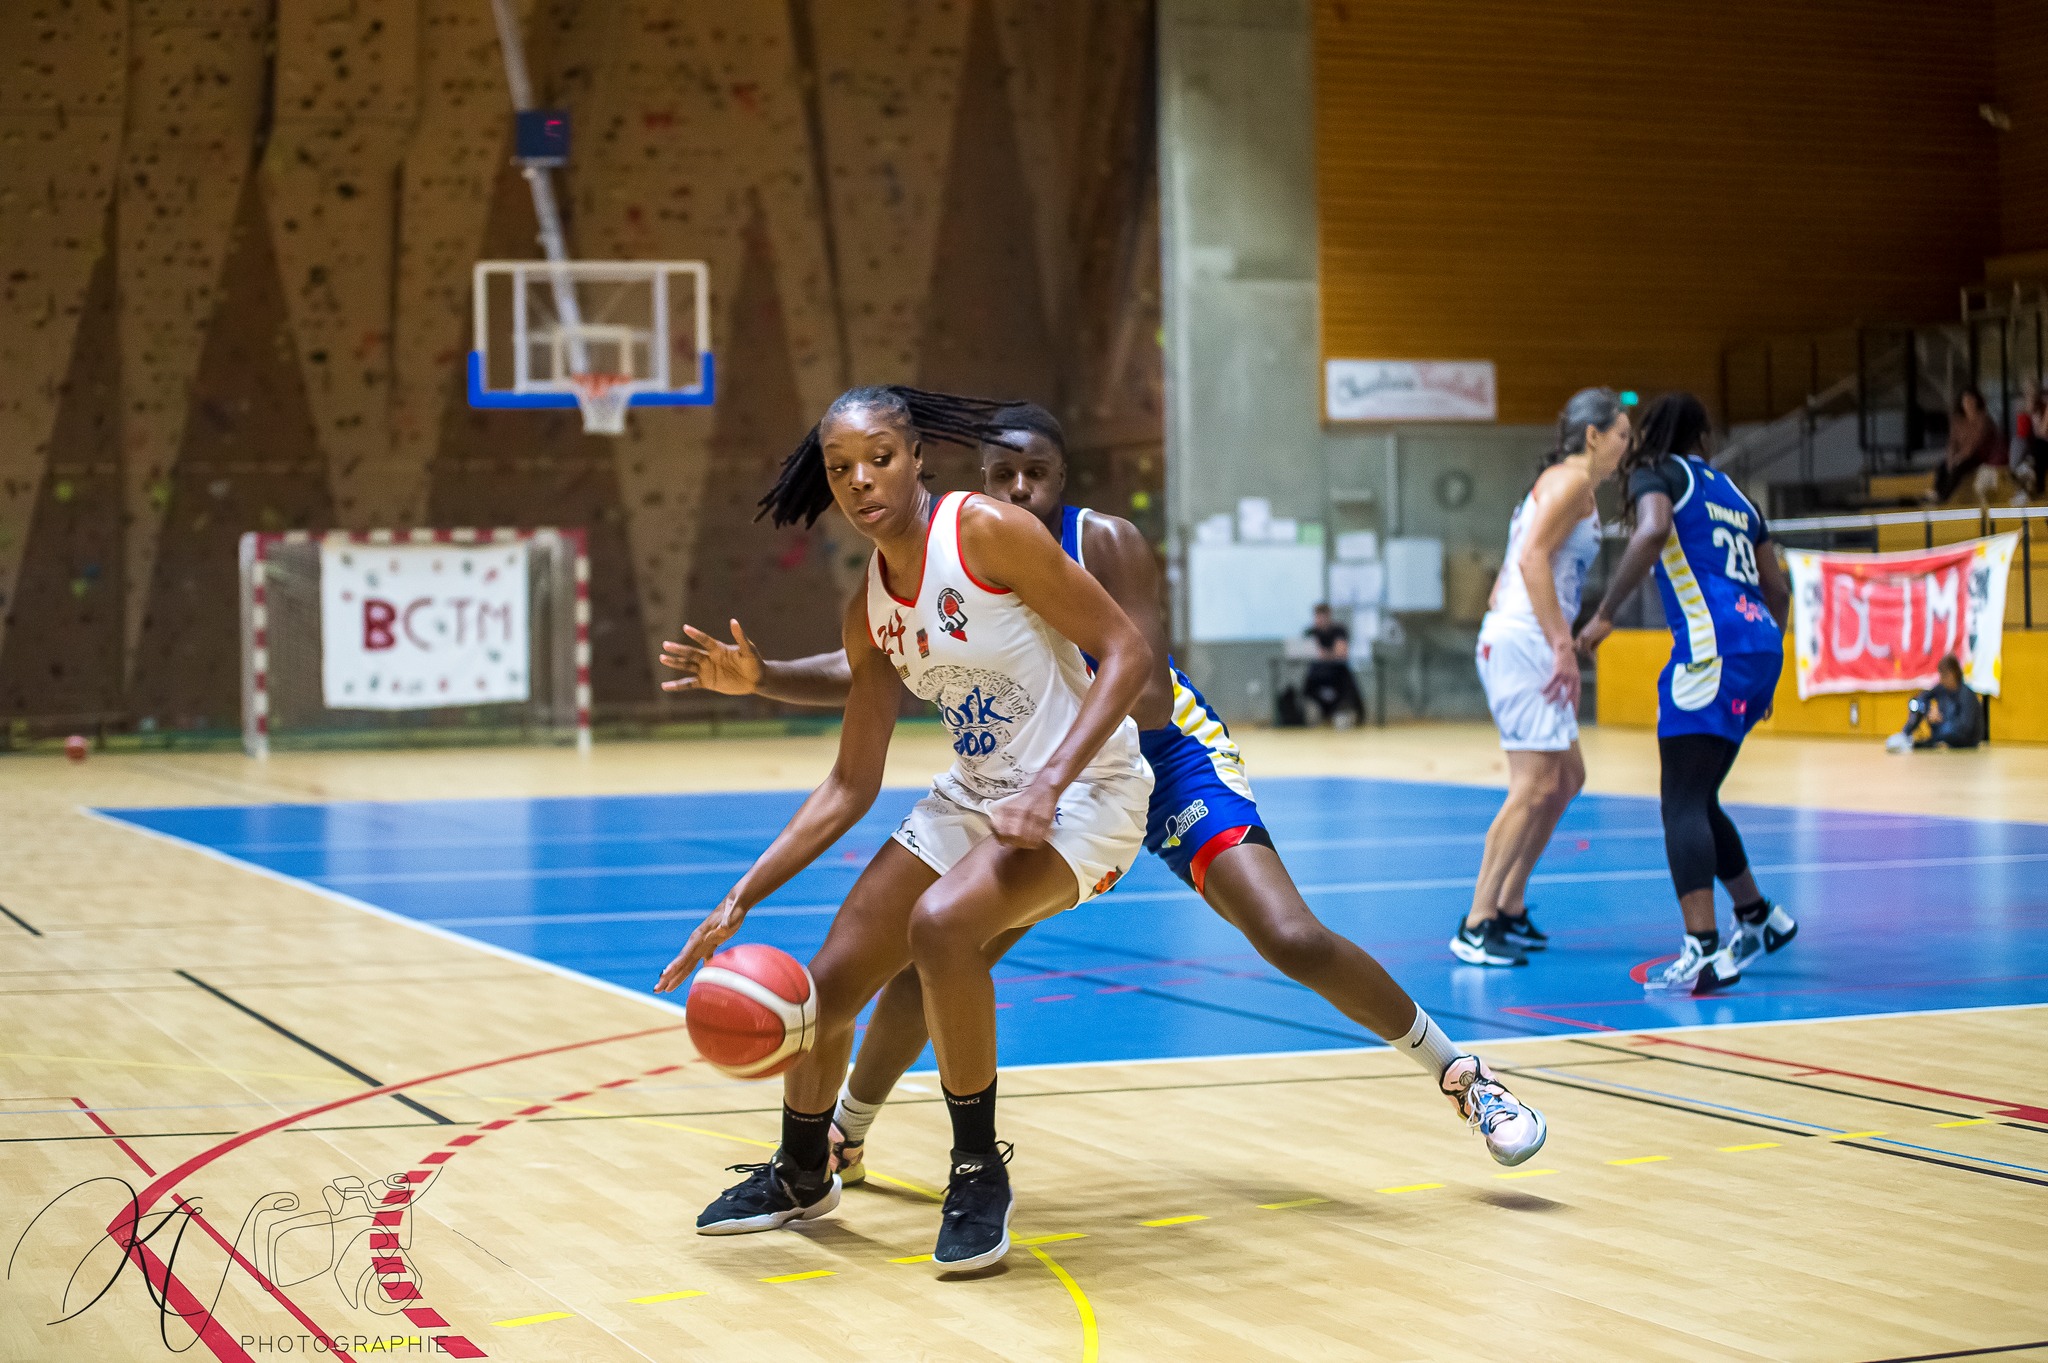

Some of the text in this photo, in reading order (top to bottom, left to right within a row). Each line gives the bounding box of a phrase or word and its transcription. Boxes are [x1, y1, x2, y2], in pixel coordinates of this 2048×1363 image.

[1712, 526, 1760, 586] 20
[362, 597, 512, 653] BCTM
[877, 609, 907, 657] 24
